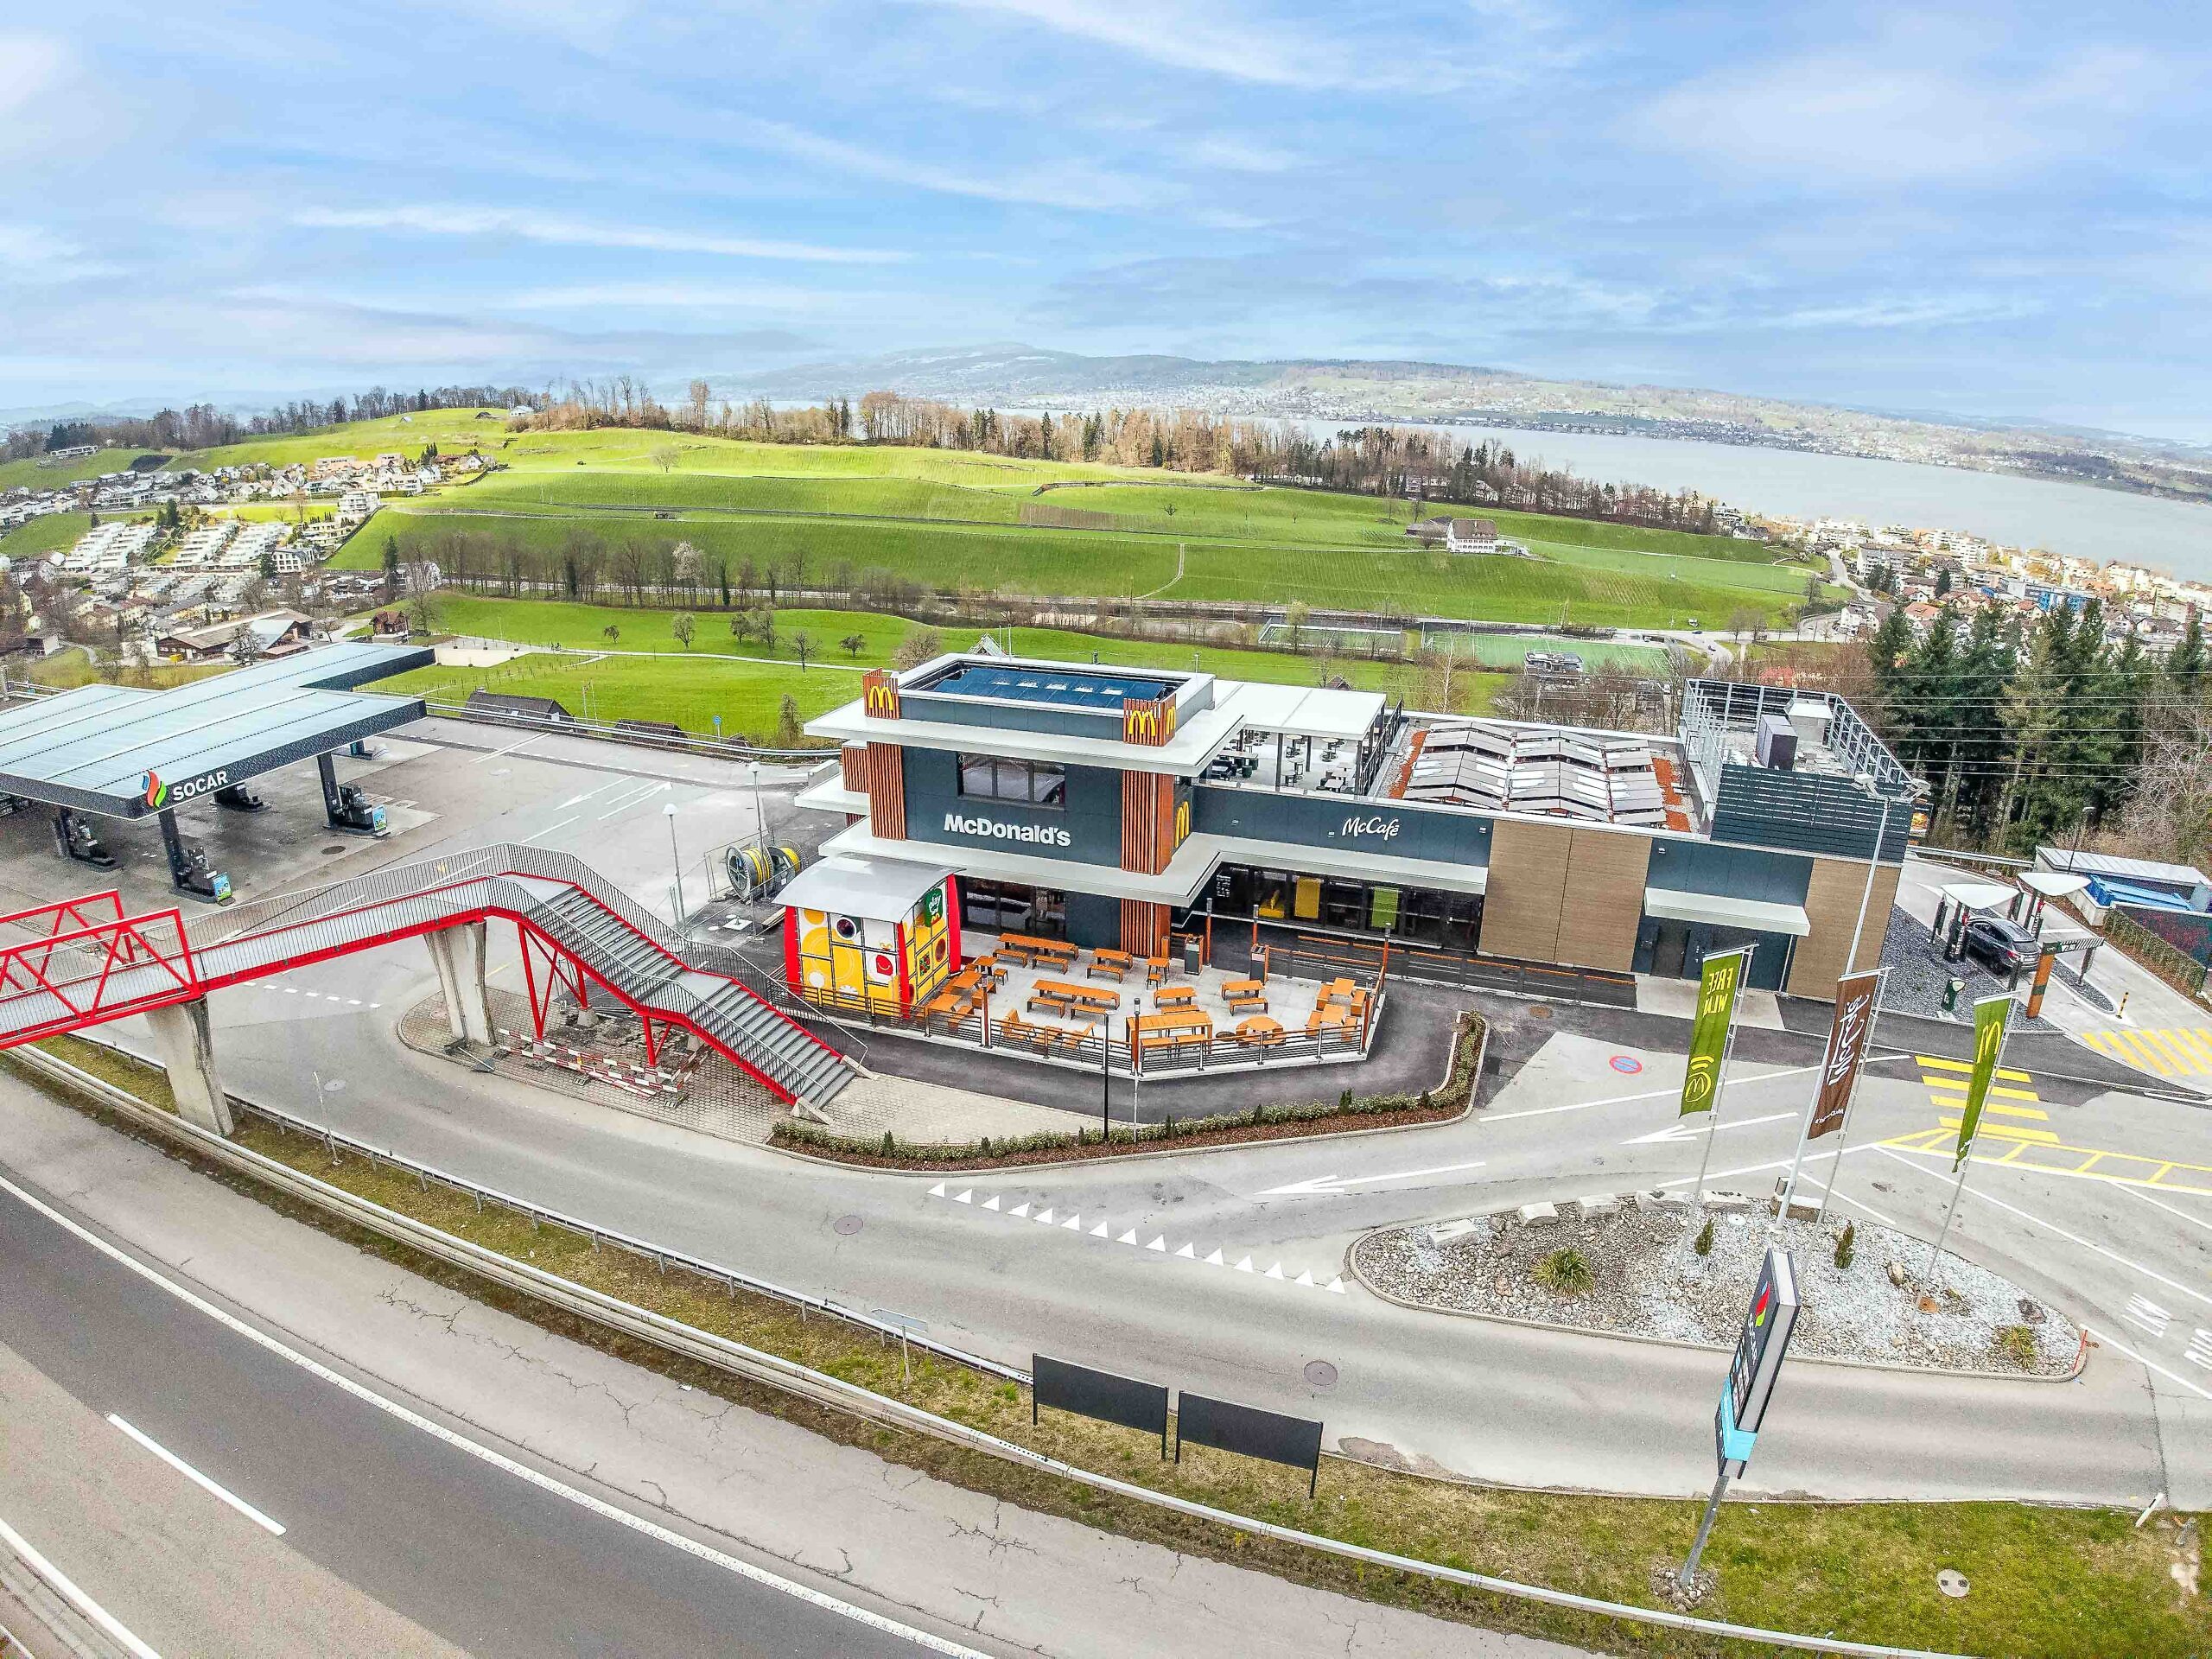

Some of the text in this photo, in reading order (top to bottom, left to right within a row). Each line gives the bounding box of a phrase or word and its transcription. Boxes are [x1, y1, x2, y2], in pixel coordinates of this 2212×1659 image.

[173, 771, 229, 801] SOCAR
[944, 814, 1071, 847] McDonald's
[1341, 817, 1400, 841] McCafé
